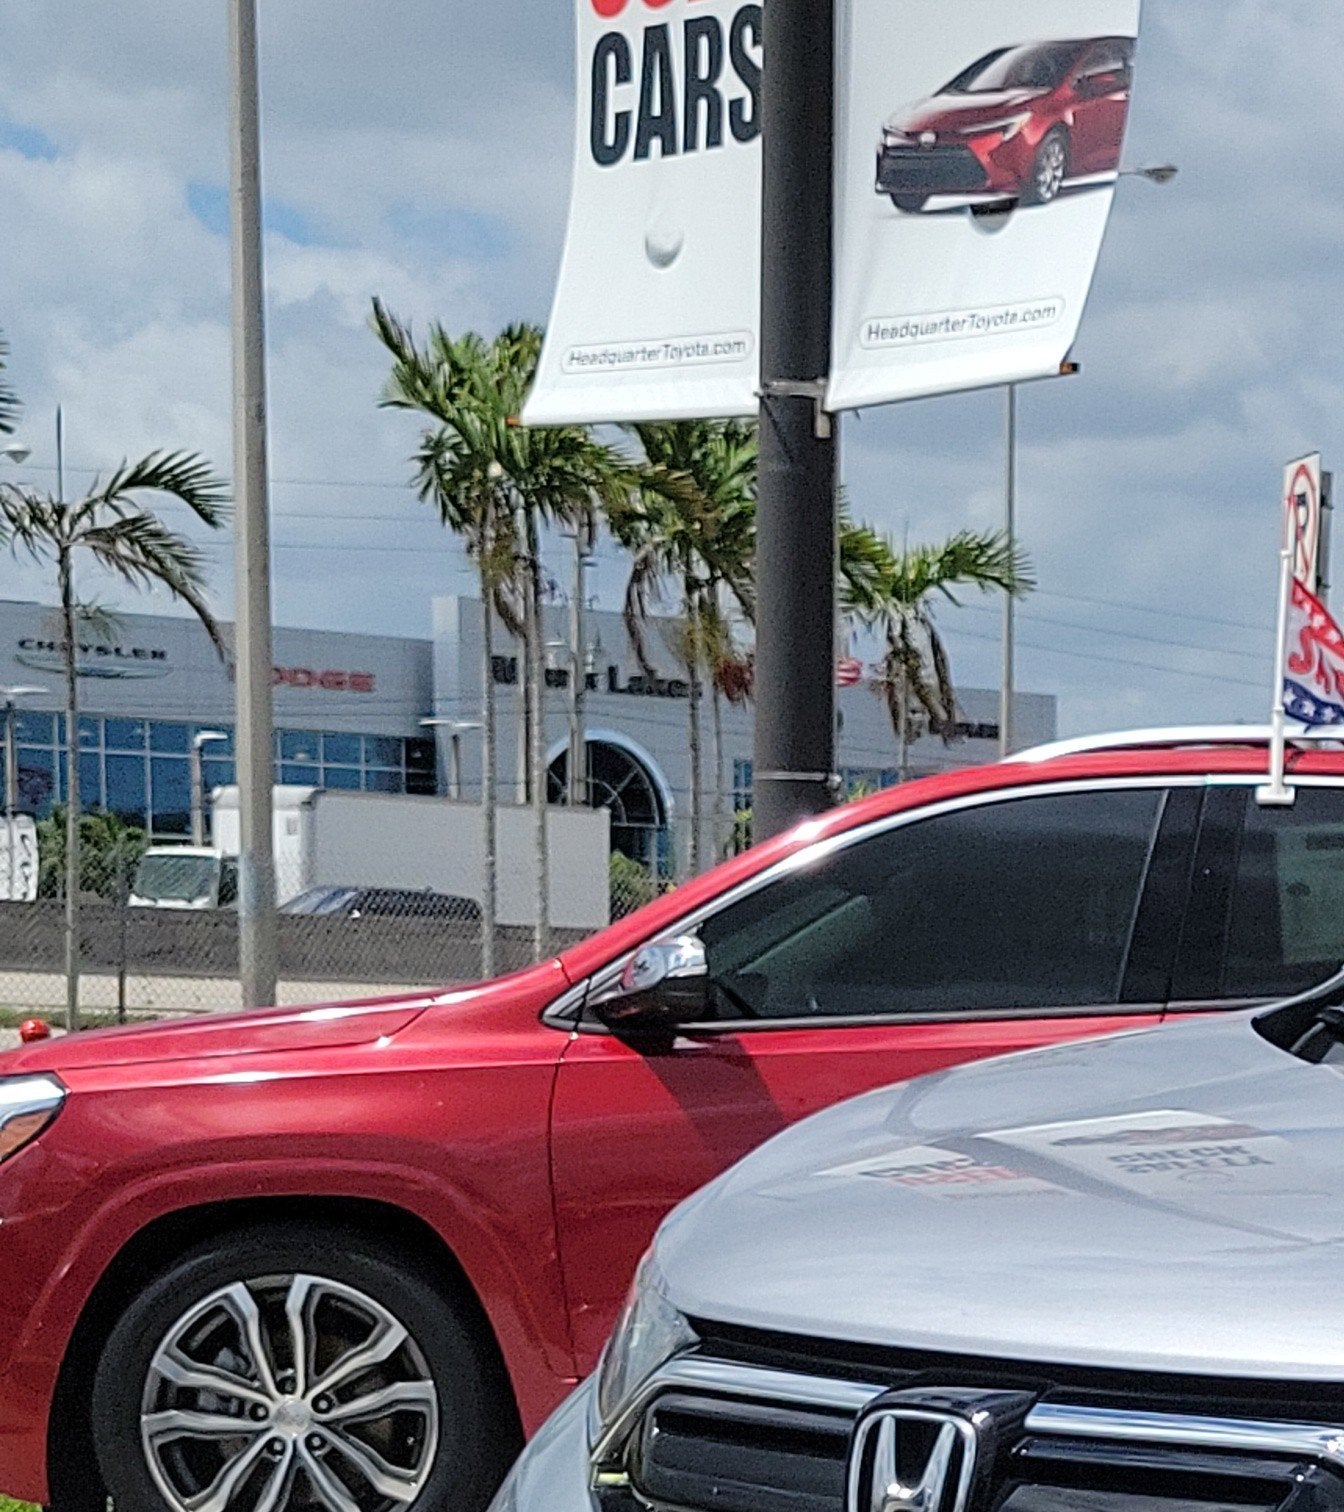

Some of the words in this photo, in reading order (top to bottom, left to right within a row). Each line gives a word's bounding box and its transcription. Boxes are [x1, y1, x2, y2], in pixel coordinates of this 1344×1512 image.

[590, 3, 764, 168] CARS
[867, 304, 1056, 342] HeadquarterToyota.com
[569, 340, 746, 367] HeadquarterToyota.com
